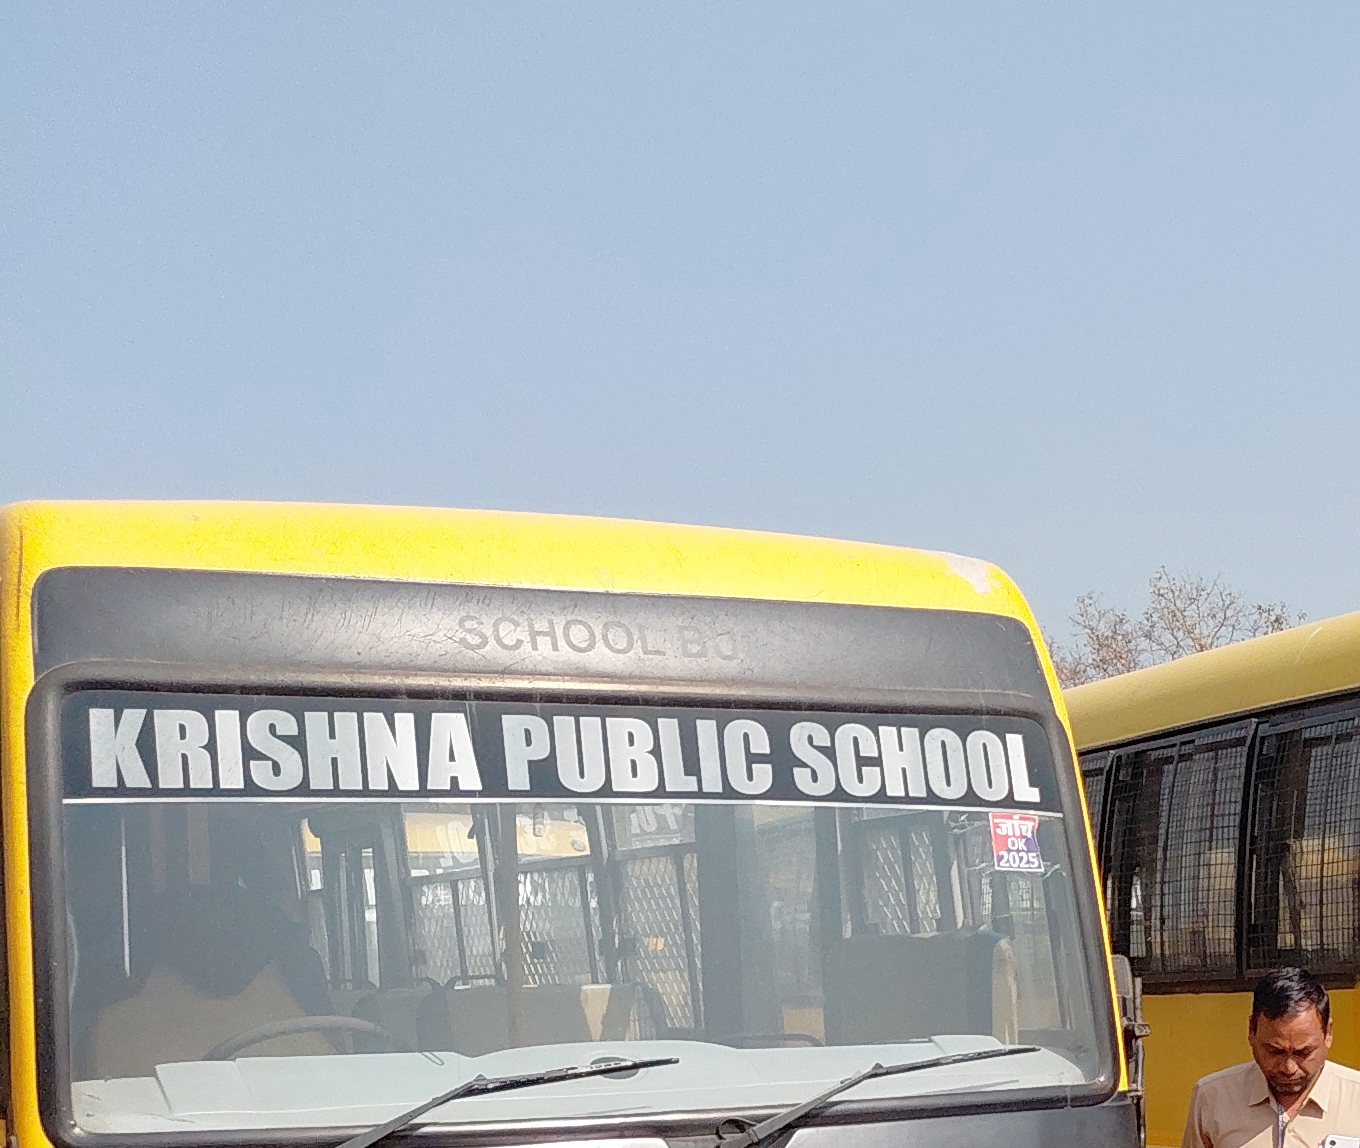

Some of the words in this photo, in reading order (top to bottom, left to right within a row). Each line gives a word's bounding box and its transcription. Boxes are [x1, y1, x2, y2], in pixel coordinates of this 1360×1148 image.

[456, 614, 666, 656] SCHOOL
[89, 706, 481, 793] KRISHNA
[503, 713, 774, 797] PUBLIC
[793, 722, 1042, 804] SCHOOL
[1007, 837, 1027, 851] OK
[998, 851, 1039, 868] 2025
